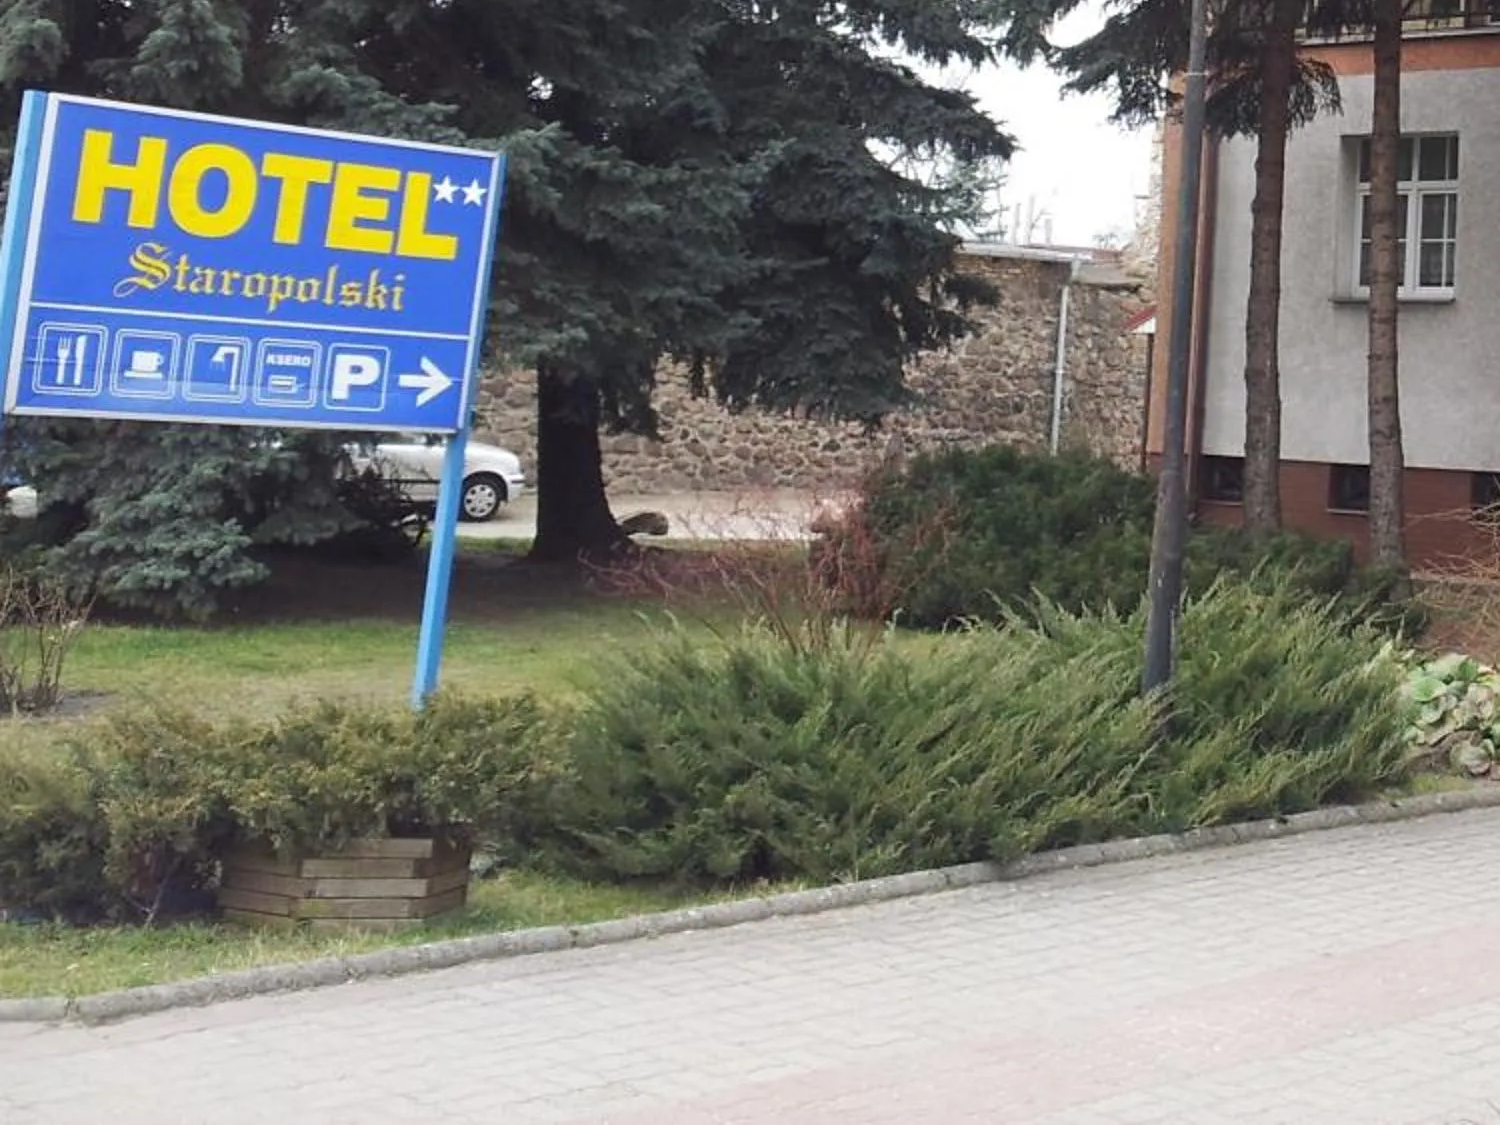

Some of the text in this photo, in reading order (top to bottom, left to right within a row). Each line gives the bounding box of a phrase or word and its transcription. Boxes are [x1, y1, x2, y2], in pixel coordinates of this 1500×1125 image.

[72, 129, 458, 261] HOTEL
[113, 241, 406, 314] Staropolski
[265, 353, 311, 368] KSERO
[331, 354, 380, 400] P
